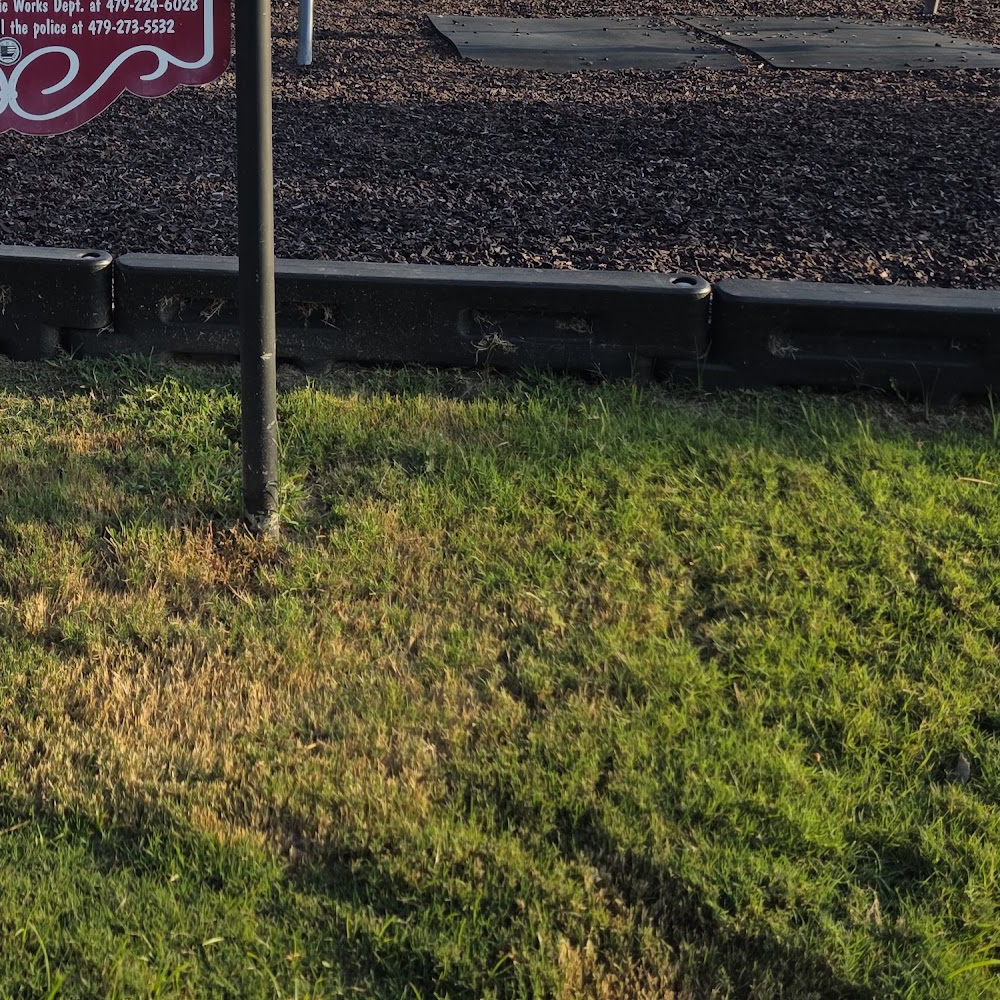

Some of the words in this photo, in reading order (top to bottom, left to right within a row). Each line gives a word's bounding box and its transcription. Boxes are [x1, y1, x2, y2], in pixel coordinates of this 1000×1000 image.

[10, 18, 28, 35] the
[33, 18, 67, 39] police
[72, 20, 83, 35] at
[88, 18, 175, 35] 479-273-5532
